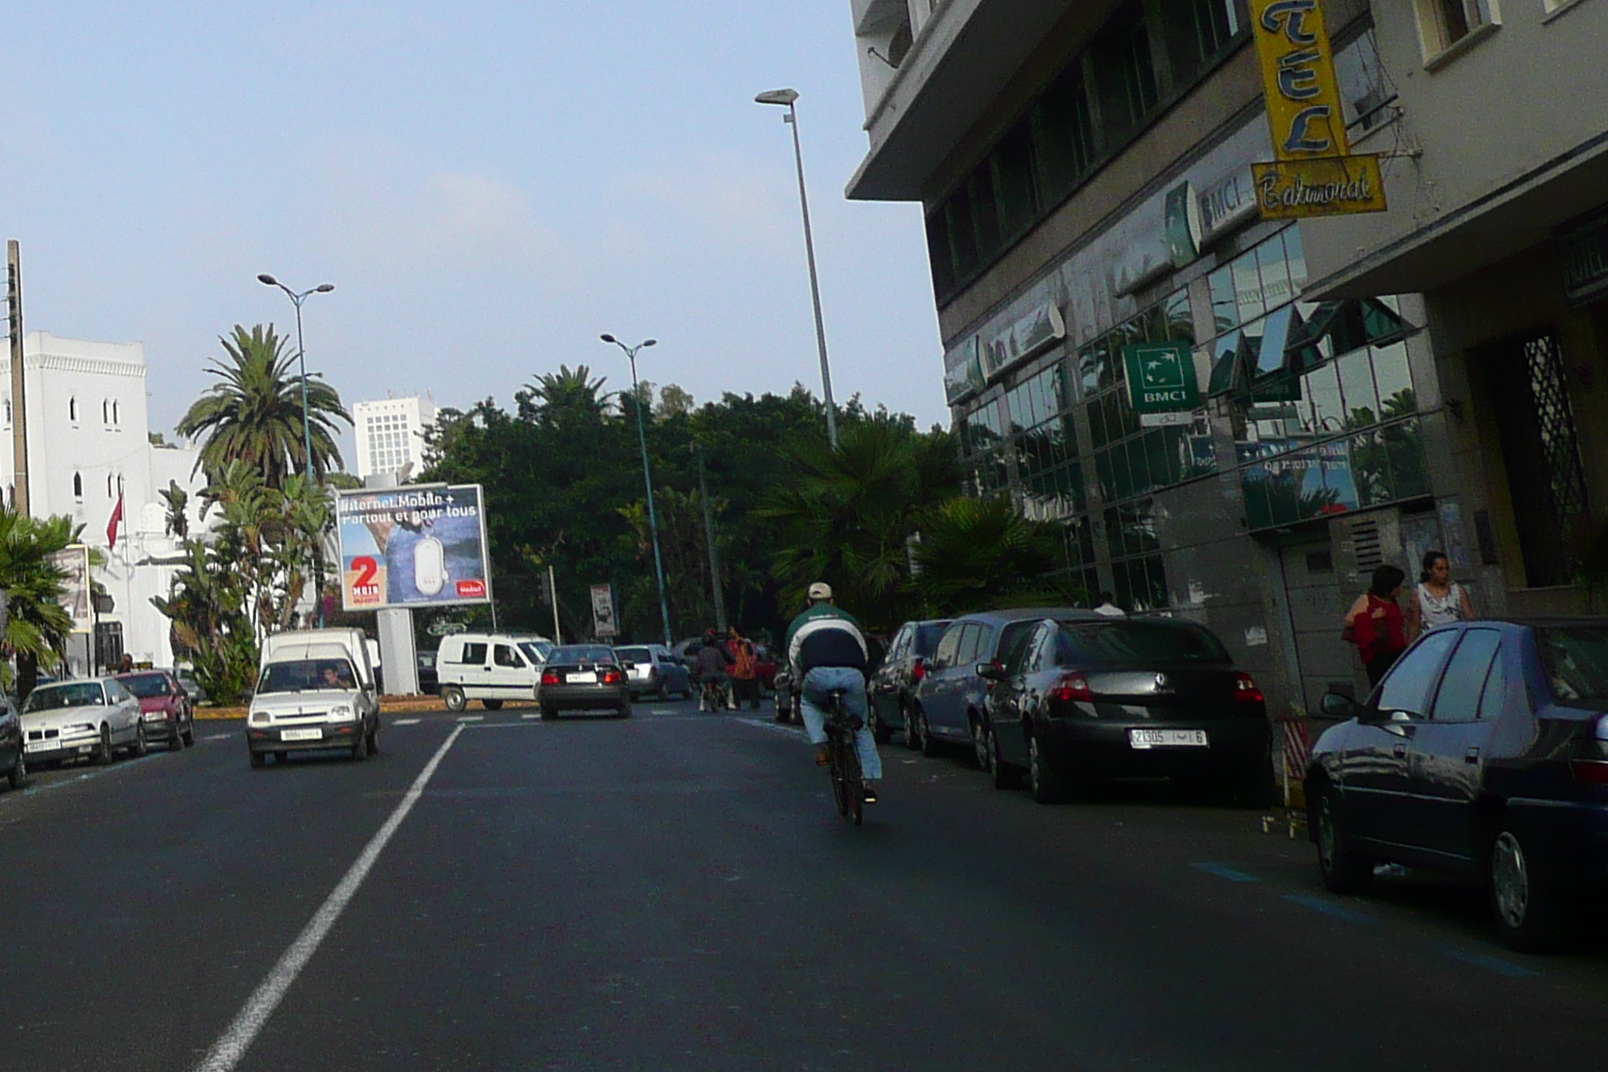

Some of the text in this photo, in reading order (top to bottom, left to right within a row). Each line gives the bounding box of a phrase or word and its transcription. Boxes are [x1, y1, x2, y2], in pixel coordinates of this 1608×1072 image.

[1259, 166, 1372, 210] Balmoral
[1201, 176, 1241, 230] BMCI
[1143, 390, 1187, 403] BMCI
[343, 505, 477, 525] Partout et pour tous
[351, 556, 377, 585] 2
[1135, 731, 1164, 742] 21305
[1196, 731, 1203, 743] 6
